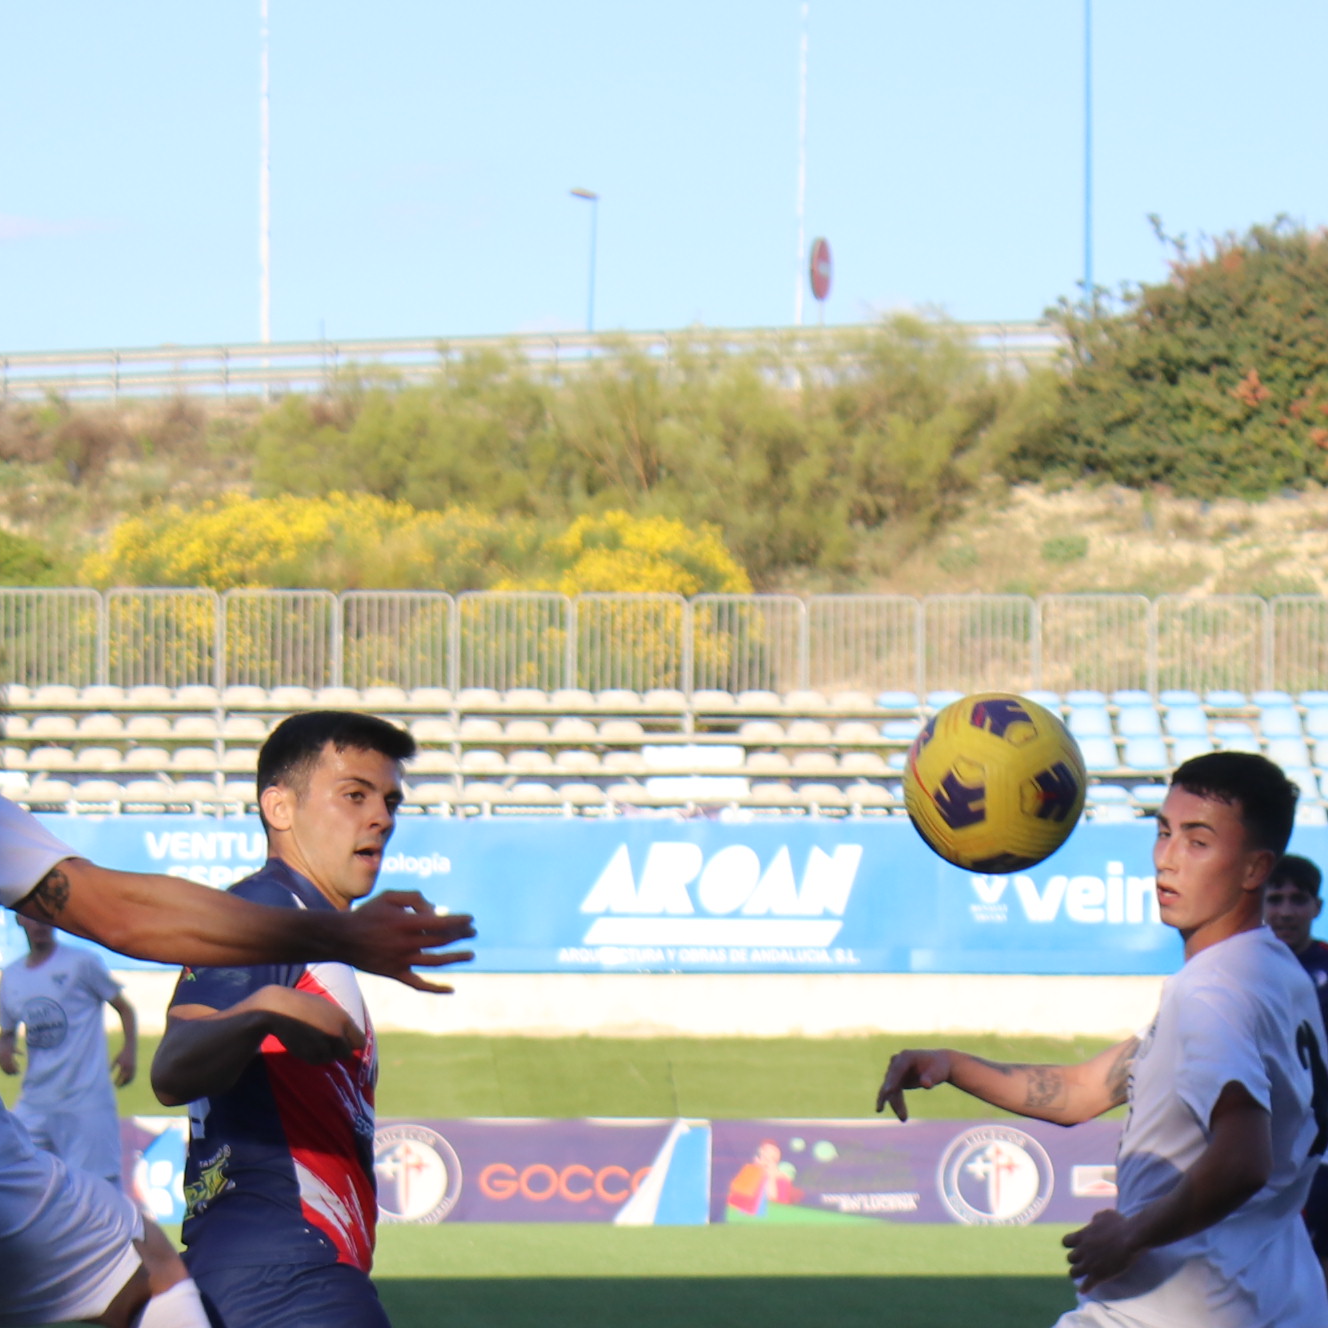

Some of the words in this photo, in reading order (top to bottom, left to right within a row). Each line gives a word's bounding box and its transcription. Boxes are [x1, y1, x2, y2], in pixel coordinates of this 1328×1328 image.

[145, 831, 268, 860] VENTU
[580, 841, 863, 915] AROAN
[666, 949, 676, 964] Y
[679, 949, 728, 964] OBRAS
[731, 949, 748, 964] DE
